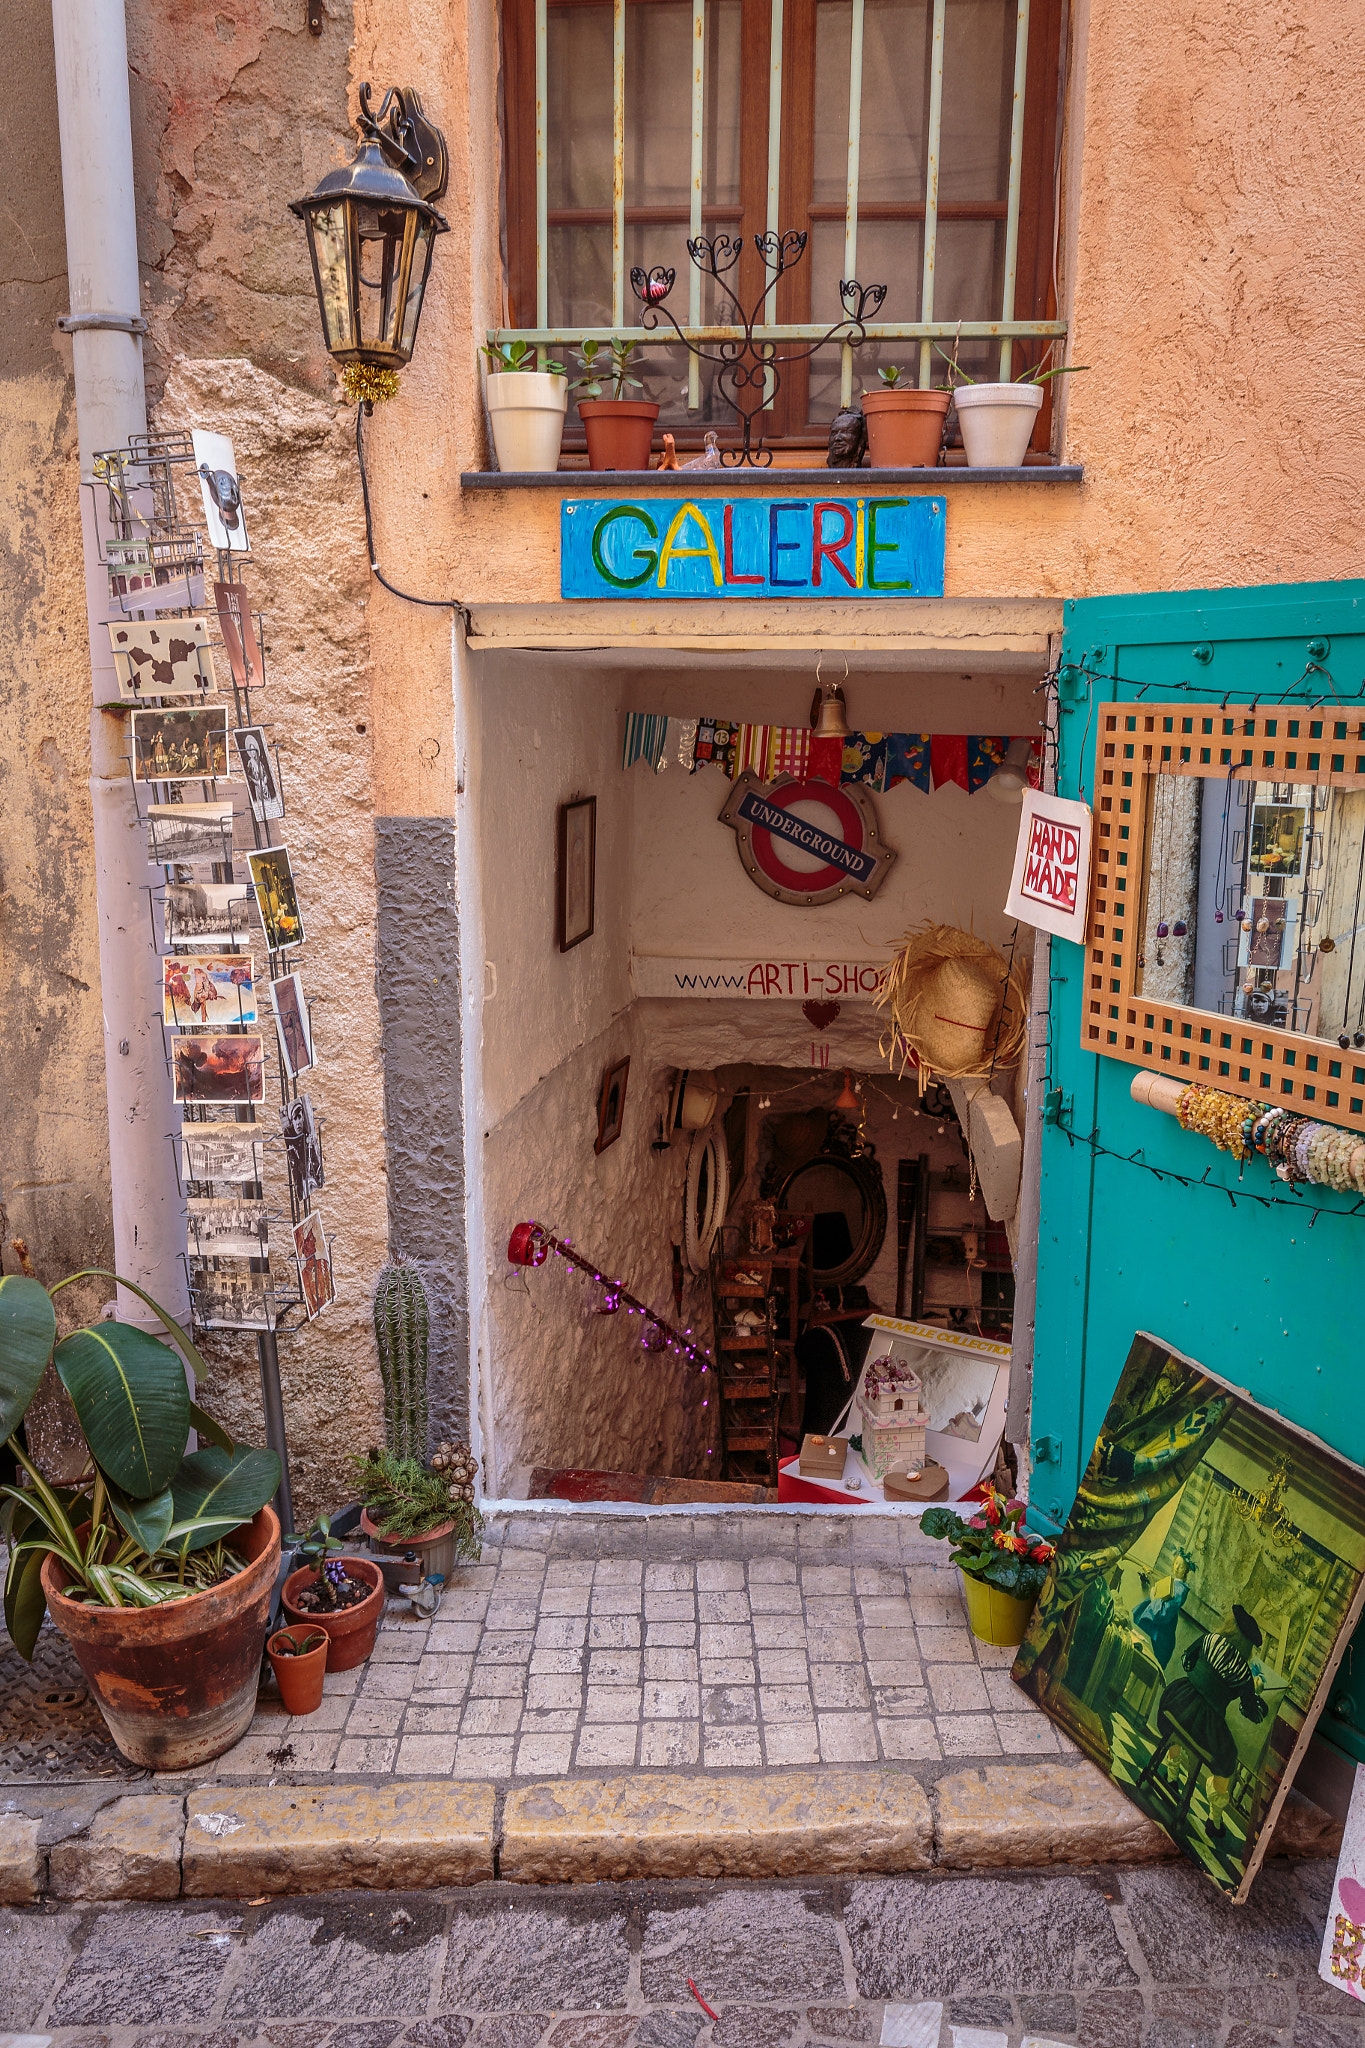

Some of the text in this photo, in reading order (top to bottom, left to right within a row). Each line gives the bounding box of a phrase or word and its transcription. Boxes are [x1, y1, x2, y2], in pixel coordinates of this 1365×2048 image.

[750, 801, 865, 871] UNDERGROUND
[1030, 819, 1077, 865] HAND
[1026, 854, 1078, 907] MADE
[871, 1316, 937, 1339] NOUVELLE
